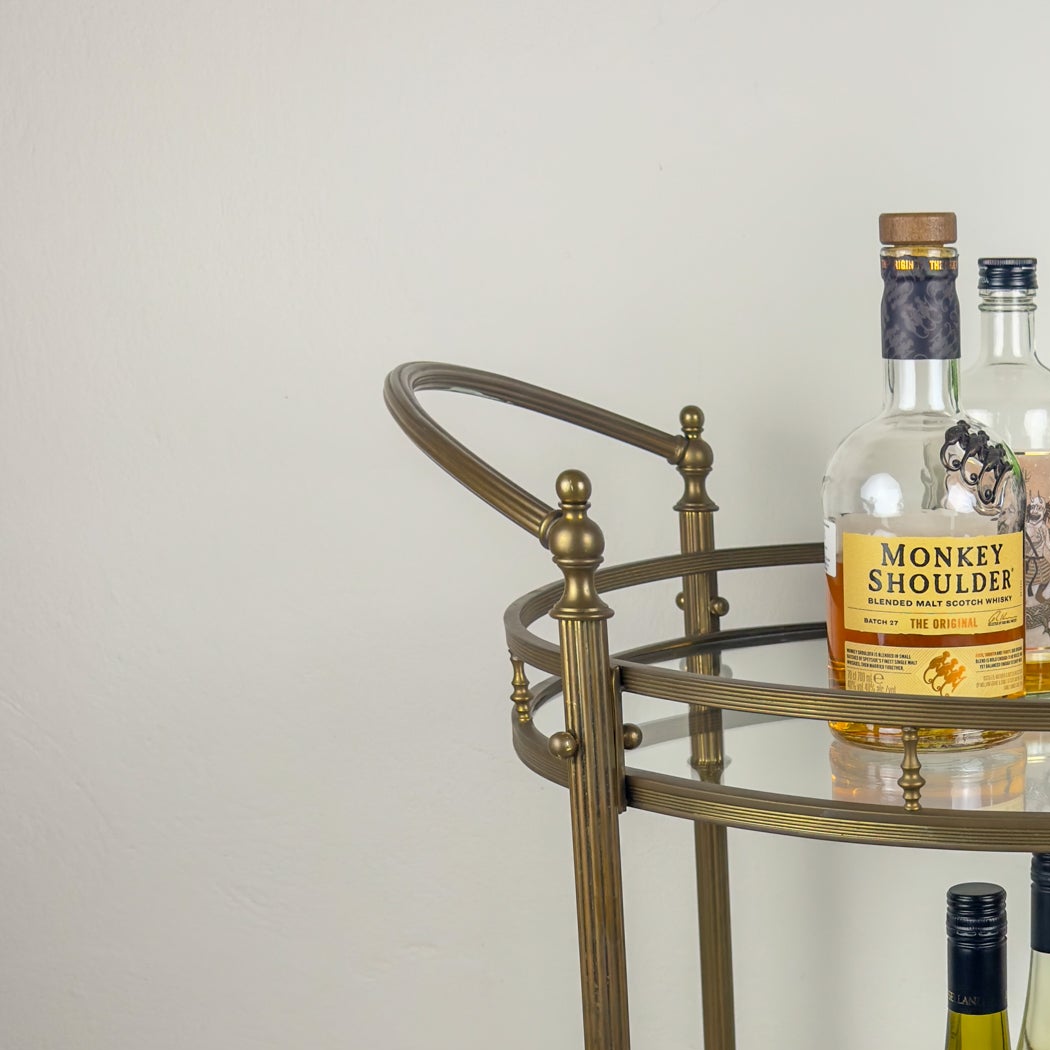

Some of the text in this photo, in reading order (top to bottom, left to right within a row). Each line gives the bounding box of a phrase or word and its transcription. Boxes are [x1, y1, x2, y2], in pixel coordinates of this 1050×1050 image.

[881, 543, 1003, 568] MONKEY
[868, 569, 1011, 594] SHOULDER
[868, 597, 912, 607] BLENDED
[946, 598, 983, 607] SCOTCH
[986, 595, 1012, 605] WHISKY
[864, 617, 887, 626] BATCH
[911, 618, 929, 630] THE
[933, 618, 978, 630] ORIGINAL
